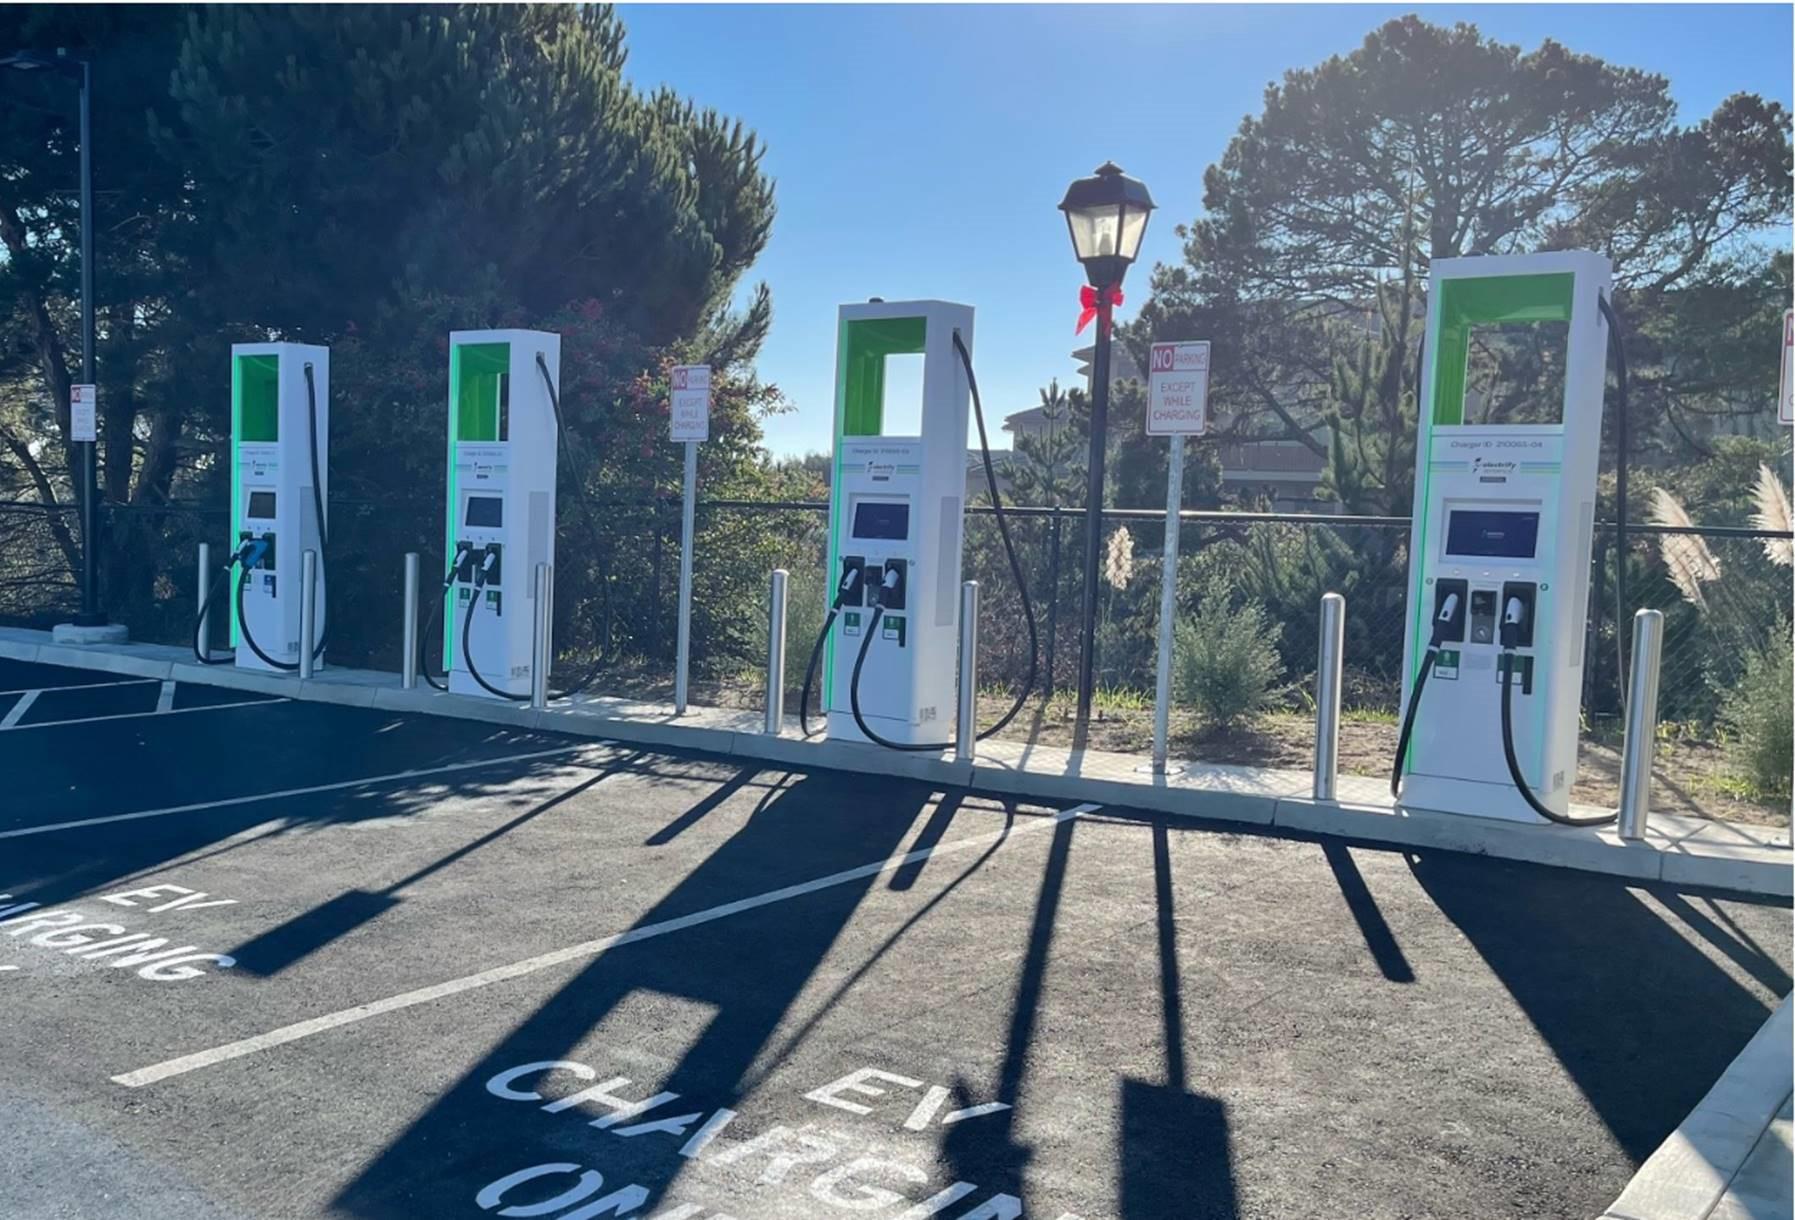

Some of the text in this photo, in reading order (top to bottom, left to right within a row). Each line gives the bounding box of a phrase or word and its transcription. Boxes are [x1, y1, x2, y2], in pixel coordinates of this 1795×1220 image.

[1153, 349, 1173, 369] NO
[1160, 381, 1196, 393] EXCEPT
[1162, 395, 1193, 407] WHILE
[1153, 409, 1201, 421] CHARGING
[1482, 462, 1517, 470] electrify
[100, 884, 240, 912] EV
[803, 1067, 1013, 1131] EV
